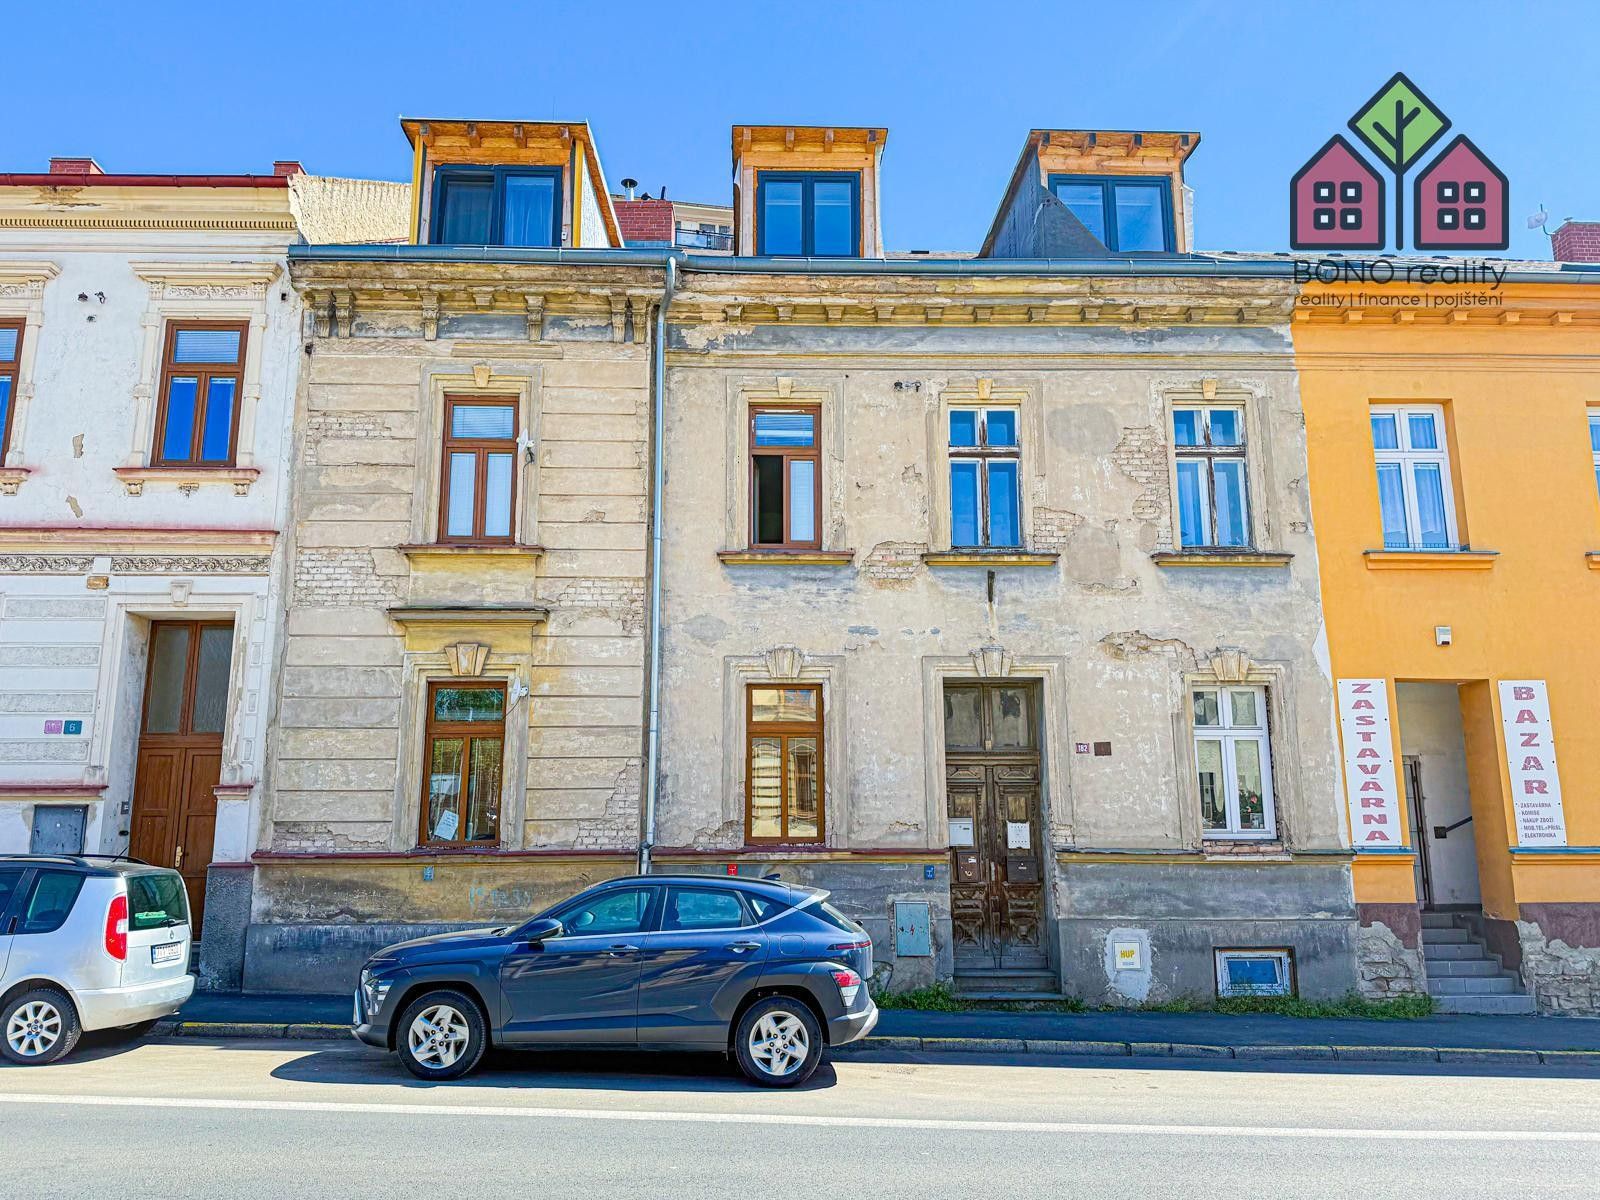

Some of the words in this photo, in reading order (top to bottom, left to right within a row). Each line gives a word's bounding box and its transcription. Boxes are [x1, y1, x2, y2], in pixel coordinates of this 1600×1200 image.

[69, 722, 76, 732] 6
[1513, 686, 1549, 794] BAZAR
[1120, 949, 1135, 959] HUP
